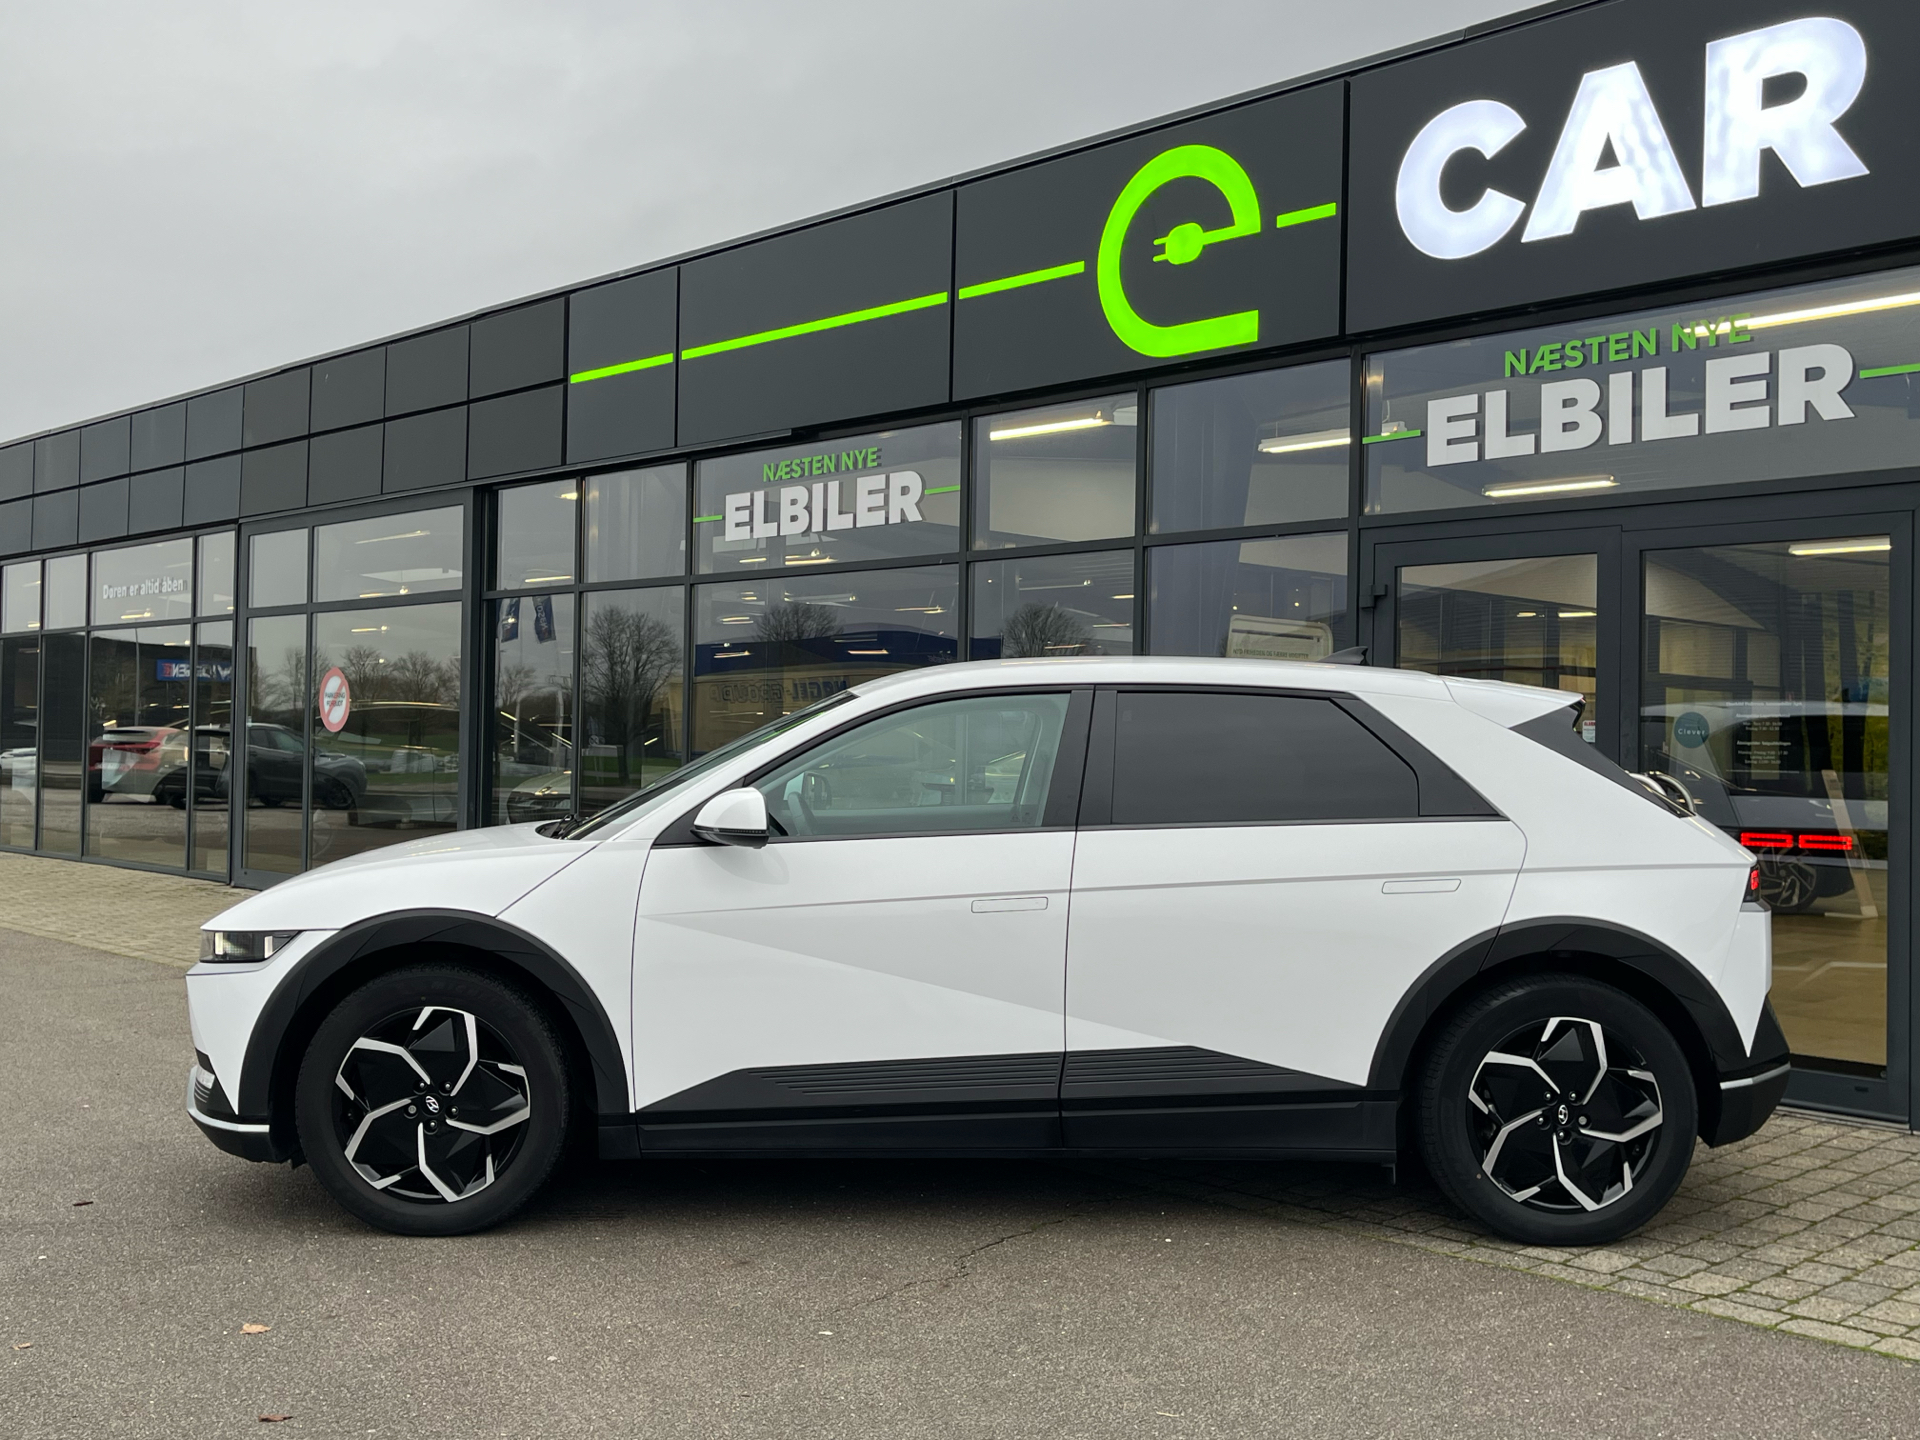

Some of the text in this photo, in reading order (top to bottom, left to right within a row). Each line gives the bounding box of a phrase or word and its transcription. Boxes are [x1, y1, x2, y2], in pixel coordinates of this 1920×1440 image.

[1396, 17, 1870, 260] CAR
[1504, 312, 1752, 378] NÆSTEN NYE
[1426, 342, 1856, 467] ELBILER
[763, 447, 878, 482] NÆSTEN NYE
[724, 470, 923, 542] ELBILER
[129, 584, 138, 596] er
[140, 577, 160, 595] altid
